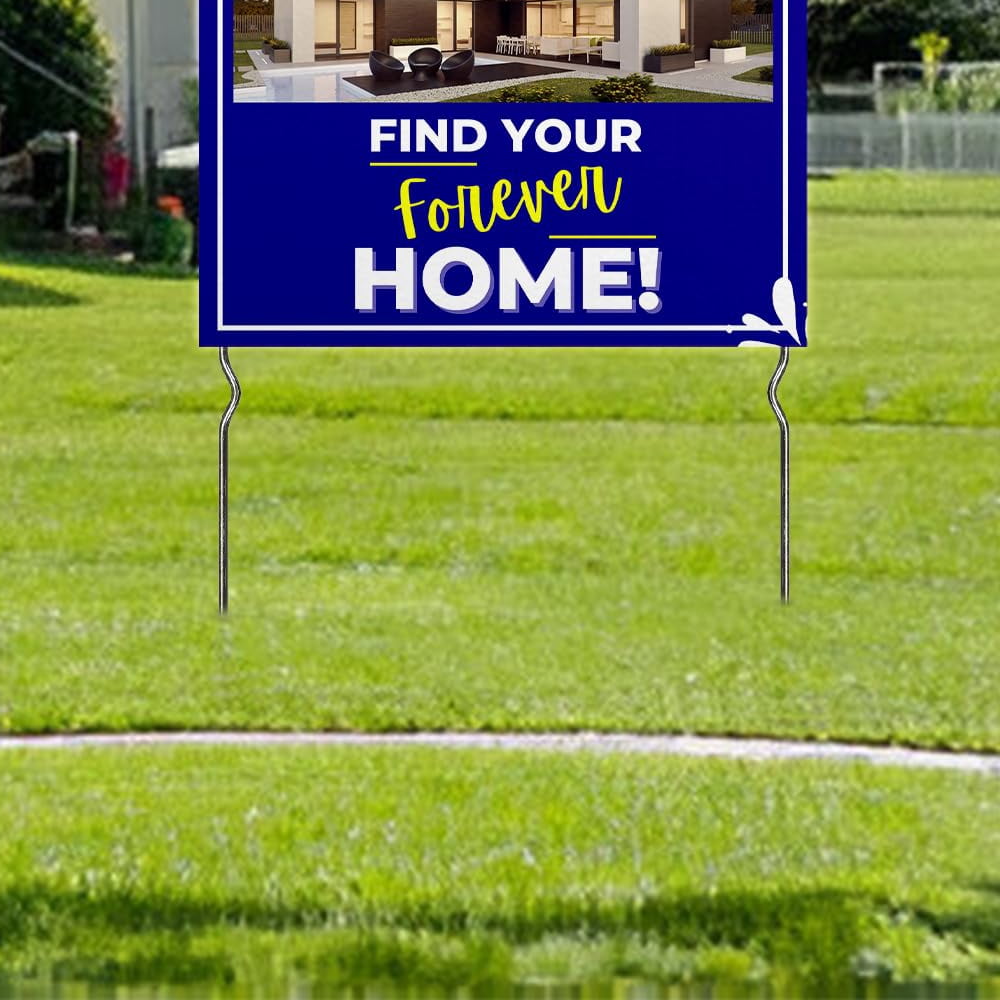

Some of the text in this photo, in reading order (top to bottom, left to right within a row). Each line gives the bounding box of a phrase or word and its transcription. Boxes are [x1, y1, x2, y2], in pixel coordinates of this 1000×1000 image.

[370, 118, 642, 153] FIND YOUR
[355, 247, 661, 312] HOME!
